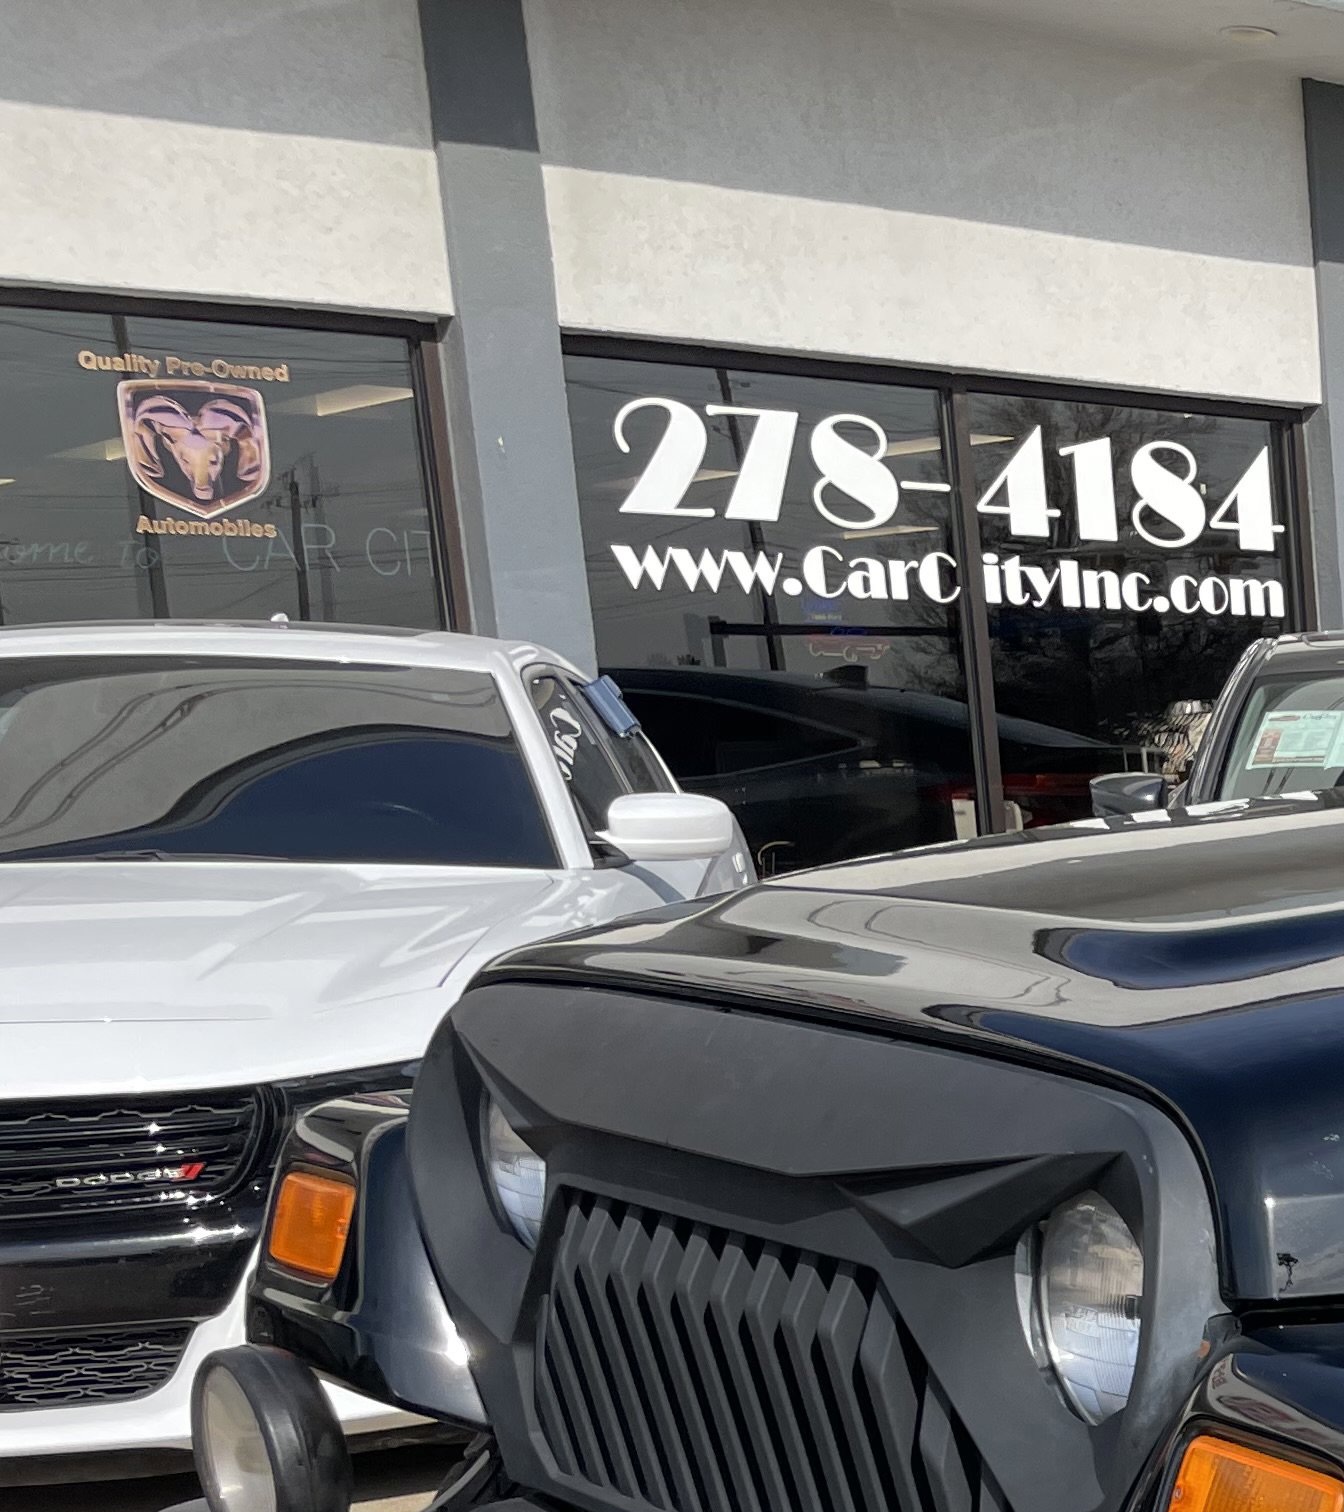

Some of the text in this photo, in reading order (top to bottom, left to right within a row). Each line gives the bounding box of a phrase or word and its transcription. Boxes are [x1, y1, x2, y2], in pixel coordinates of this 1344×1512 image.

[77, 350, 290, 383] Quality Pre-Owned
[136, 514, 278, 539] Automobiles
[610, 544, 1285, 618] www.CarCityInc.com
[55, 1167, 186, 1188] DODGE
